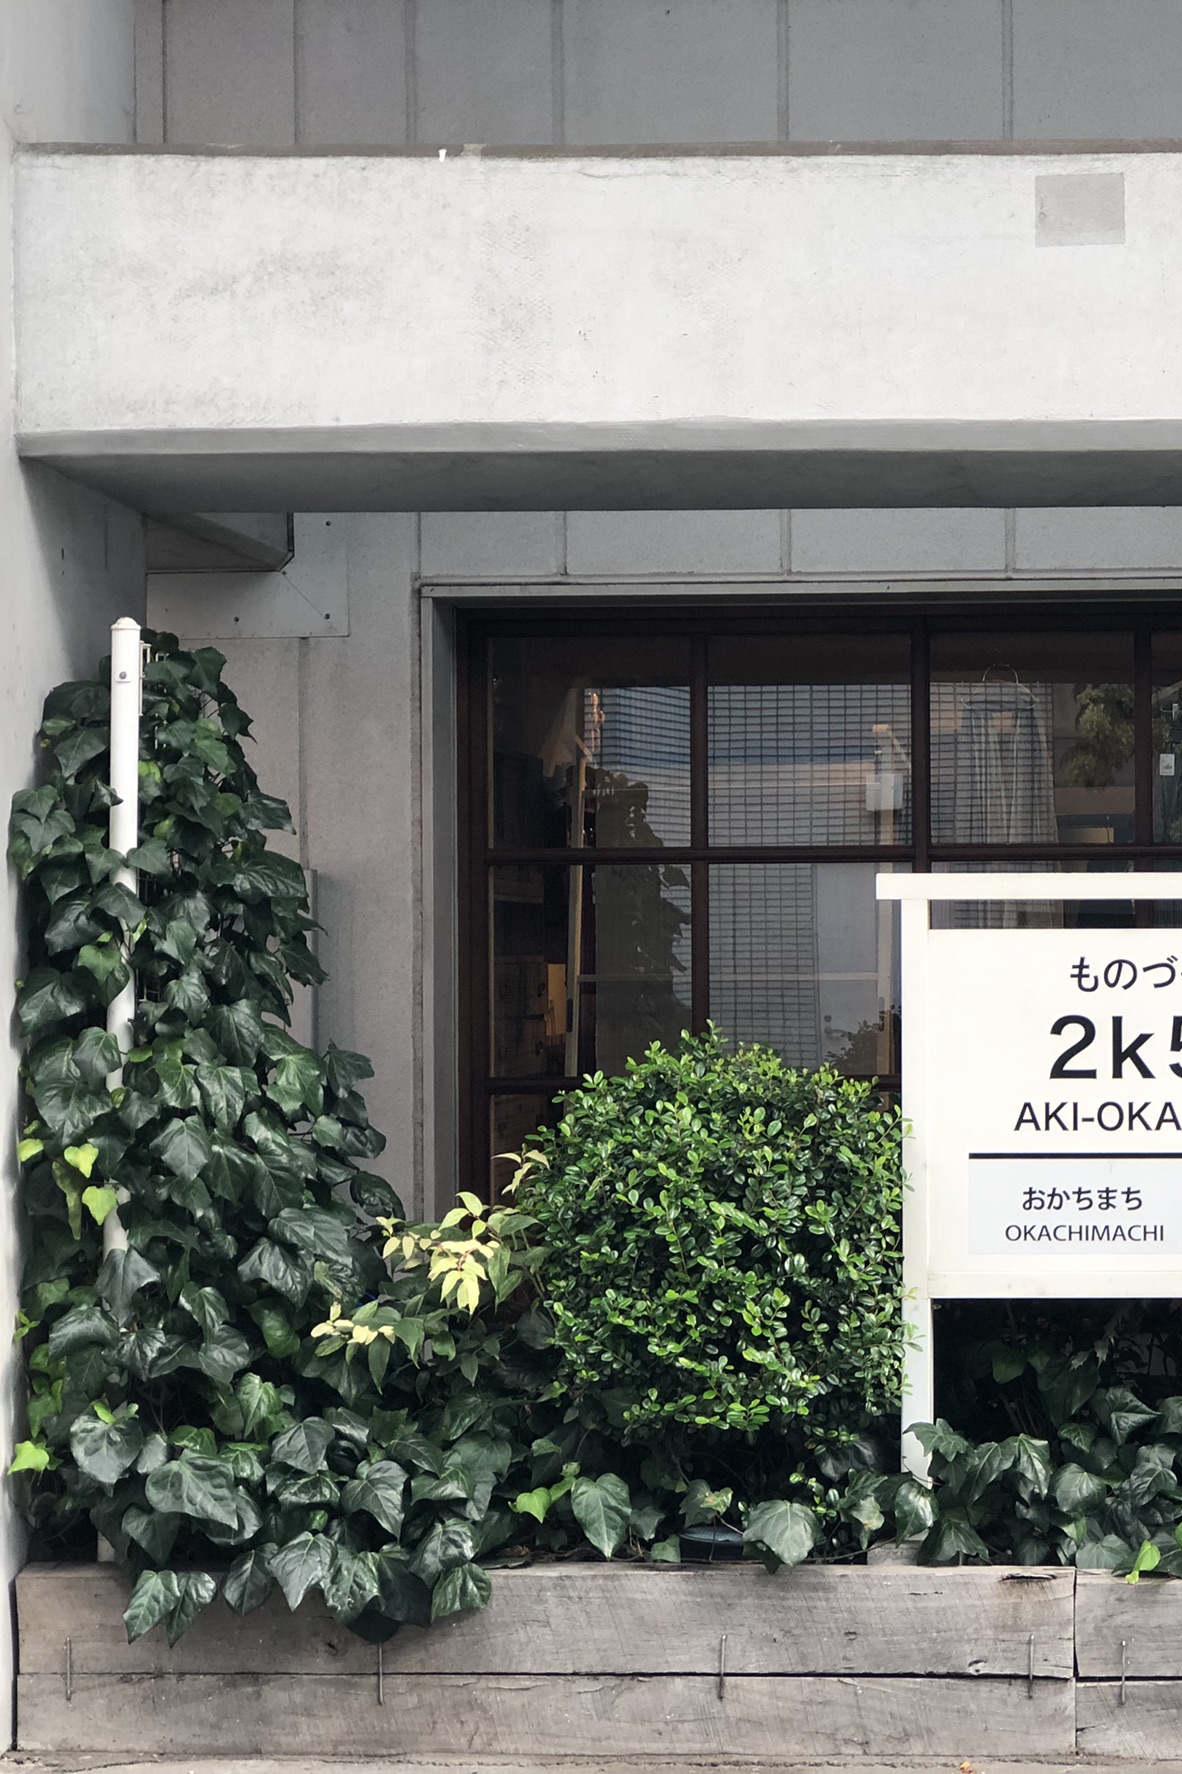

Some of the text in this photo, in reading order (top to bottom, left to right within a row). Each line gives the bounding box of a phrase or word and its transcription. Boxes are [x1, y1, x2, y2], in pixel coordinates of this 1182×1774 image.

[1013, 1101, 1182, 1132] AKI-OKA
[1021, 1186, 1143, 1211] おかちまち
[1005, 1224, 1165, 1242] OKACHIMACHI
